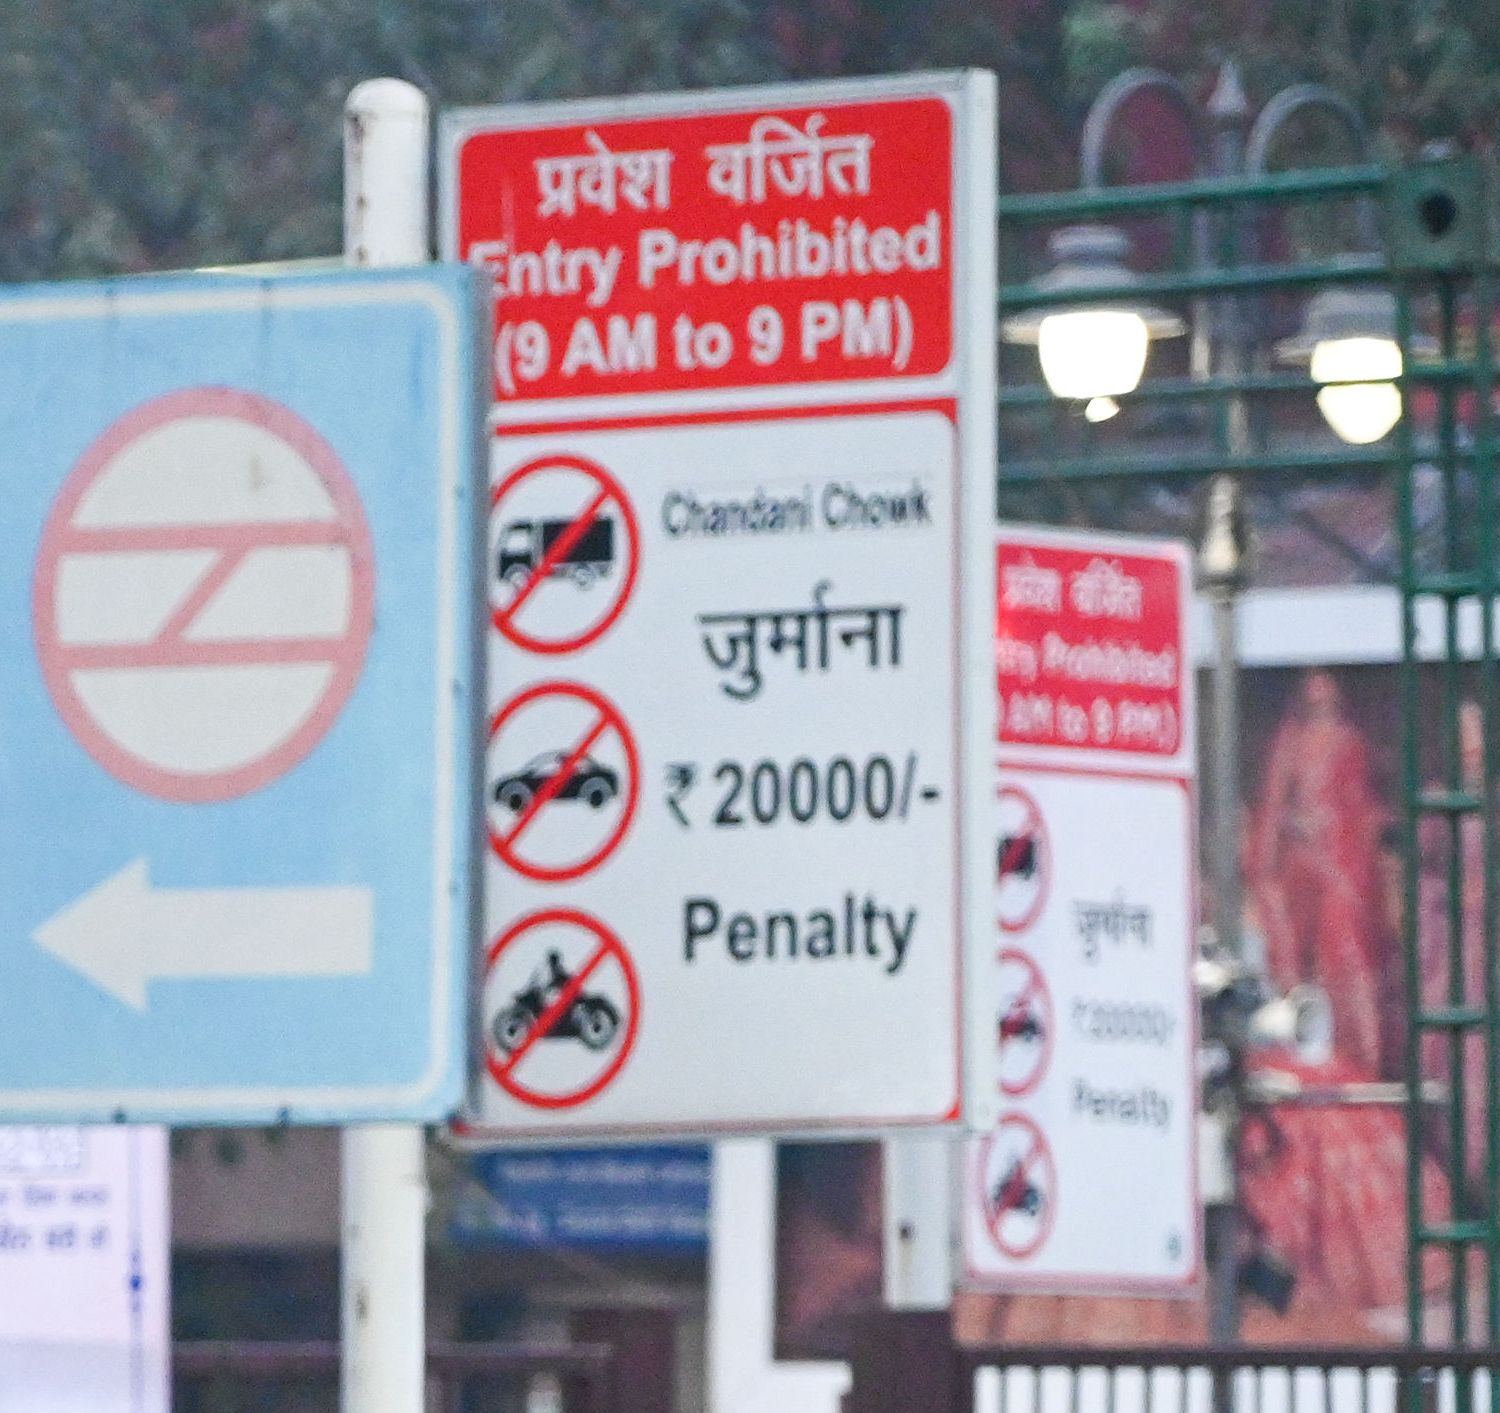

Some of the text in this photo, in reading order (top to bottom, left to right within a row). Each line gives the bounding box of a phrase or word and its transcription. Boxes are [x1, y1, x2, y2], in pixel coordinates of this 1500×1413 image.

[533, 113, 873, 219] प्रवेश वर्जित
[639, 210, 941, 289] Prohibited
[495, 296, 913, 395] (9 AM to 9 PM)
[662, 478, 933, 538] Chandani Chowk
[696, 579, 904, 702] जुर्माना
[682, 893, 917, 974] Penalty
